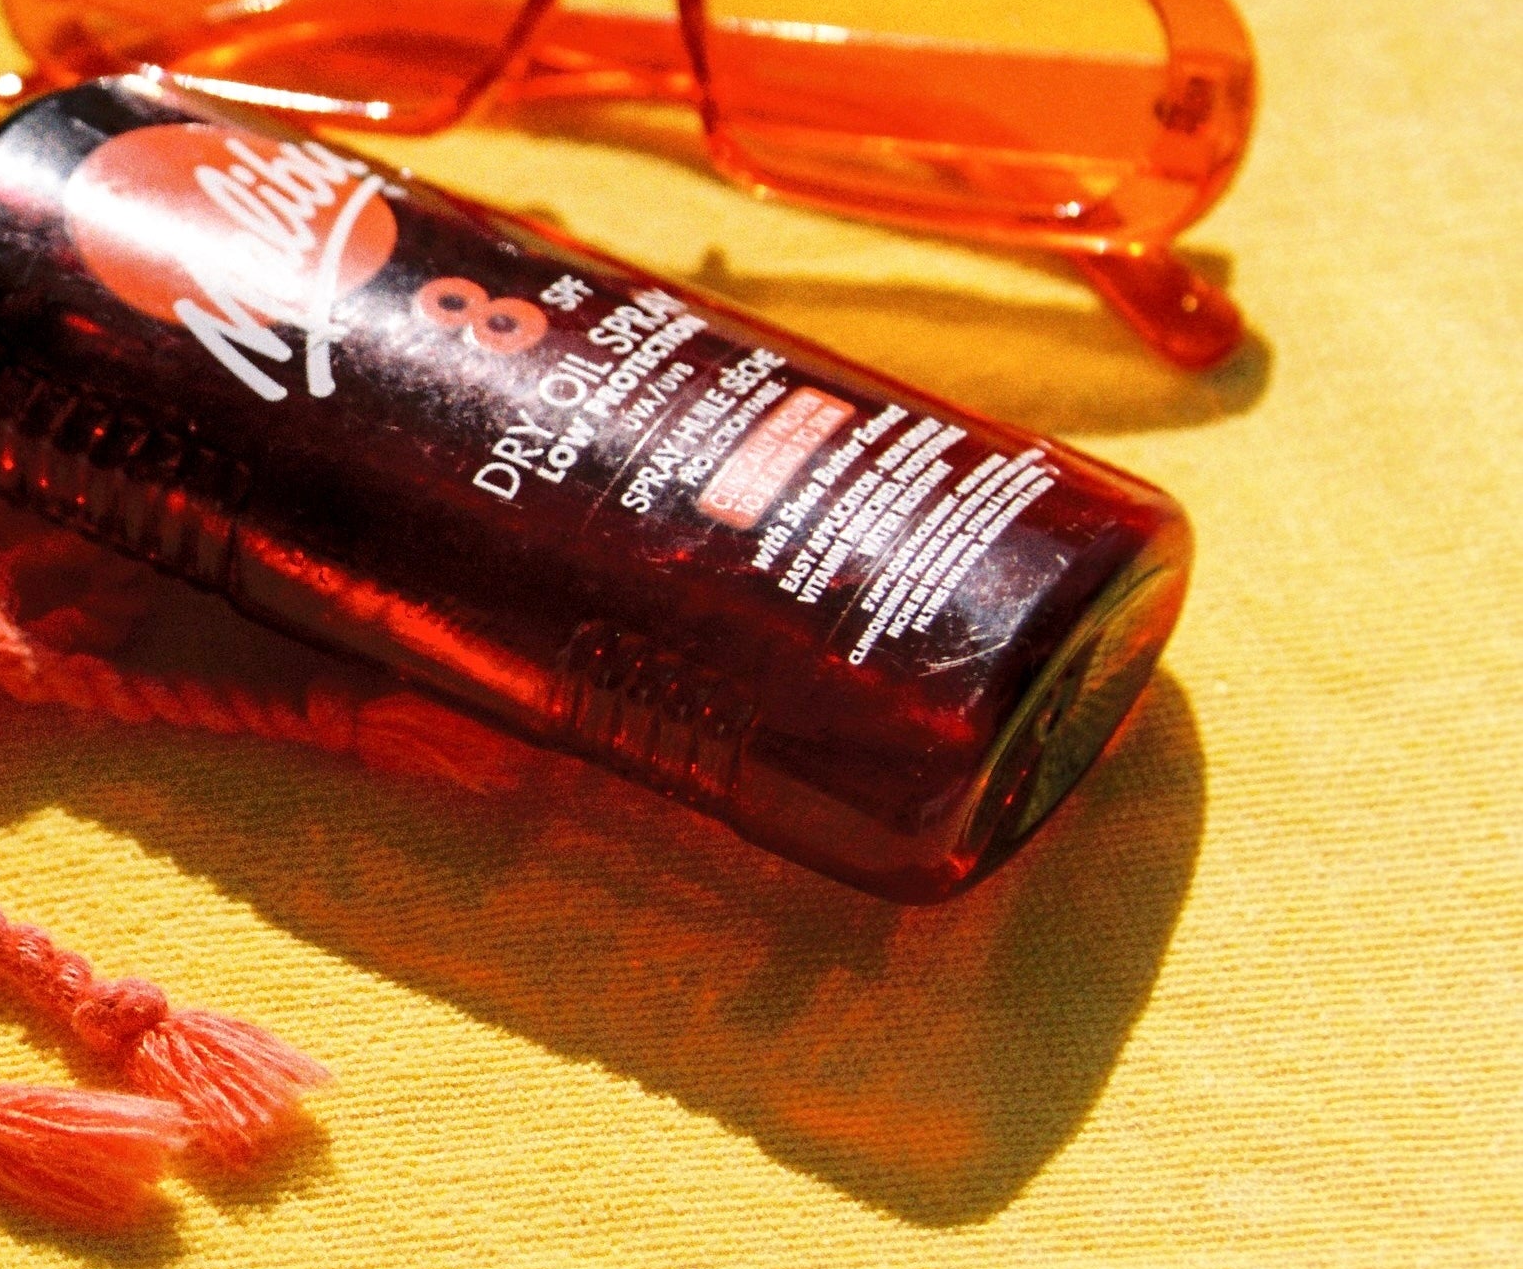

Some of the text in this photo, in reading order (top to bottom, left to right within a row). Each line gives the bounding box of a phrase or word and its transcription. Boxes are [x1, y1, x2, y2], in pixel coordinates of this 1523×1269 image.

[174, 140, 370, 401] Malibu
[412, 273, 594, 355] 8 SPF
[471, 286, 689, 499] DRY OIL SPRAY
[535, 312, 709, 483] LOW PROTECTION
[620, 360, 696, 429] UVA/UVB
[618, 437, 683, 514] SPRAY
[669, 387, 737, 443] HUILE
[733, 492, 766, 517] TO
[751, 527, 793, 570] with
[781, 481, 826, 528] Shea
[811, 438, 866, 485] Butter
[778, 549, 816, 593] EASY
[808, 469, 882, 554] APPLICATION
[856, 510, 903, 556] WATER
[797, 539, 852, 603] VITAMIN
[860, 546, 918, 611] S'APPLIQUE
[884, 600, 921, 637] RICHE
[909, 584, 931, 602] EN
[911, 585, 951, 632] FILTRES
[847, 576, 916, 664] CLINIQUEMENT
